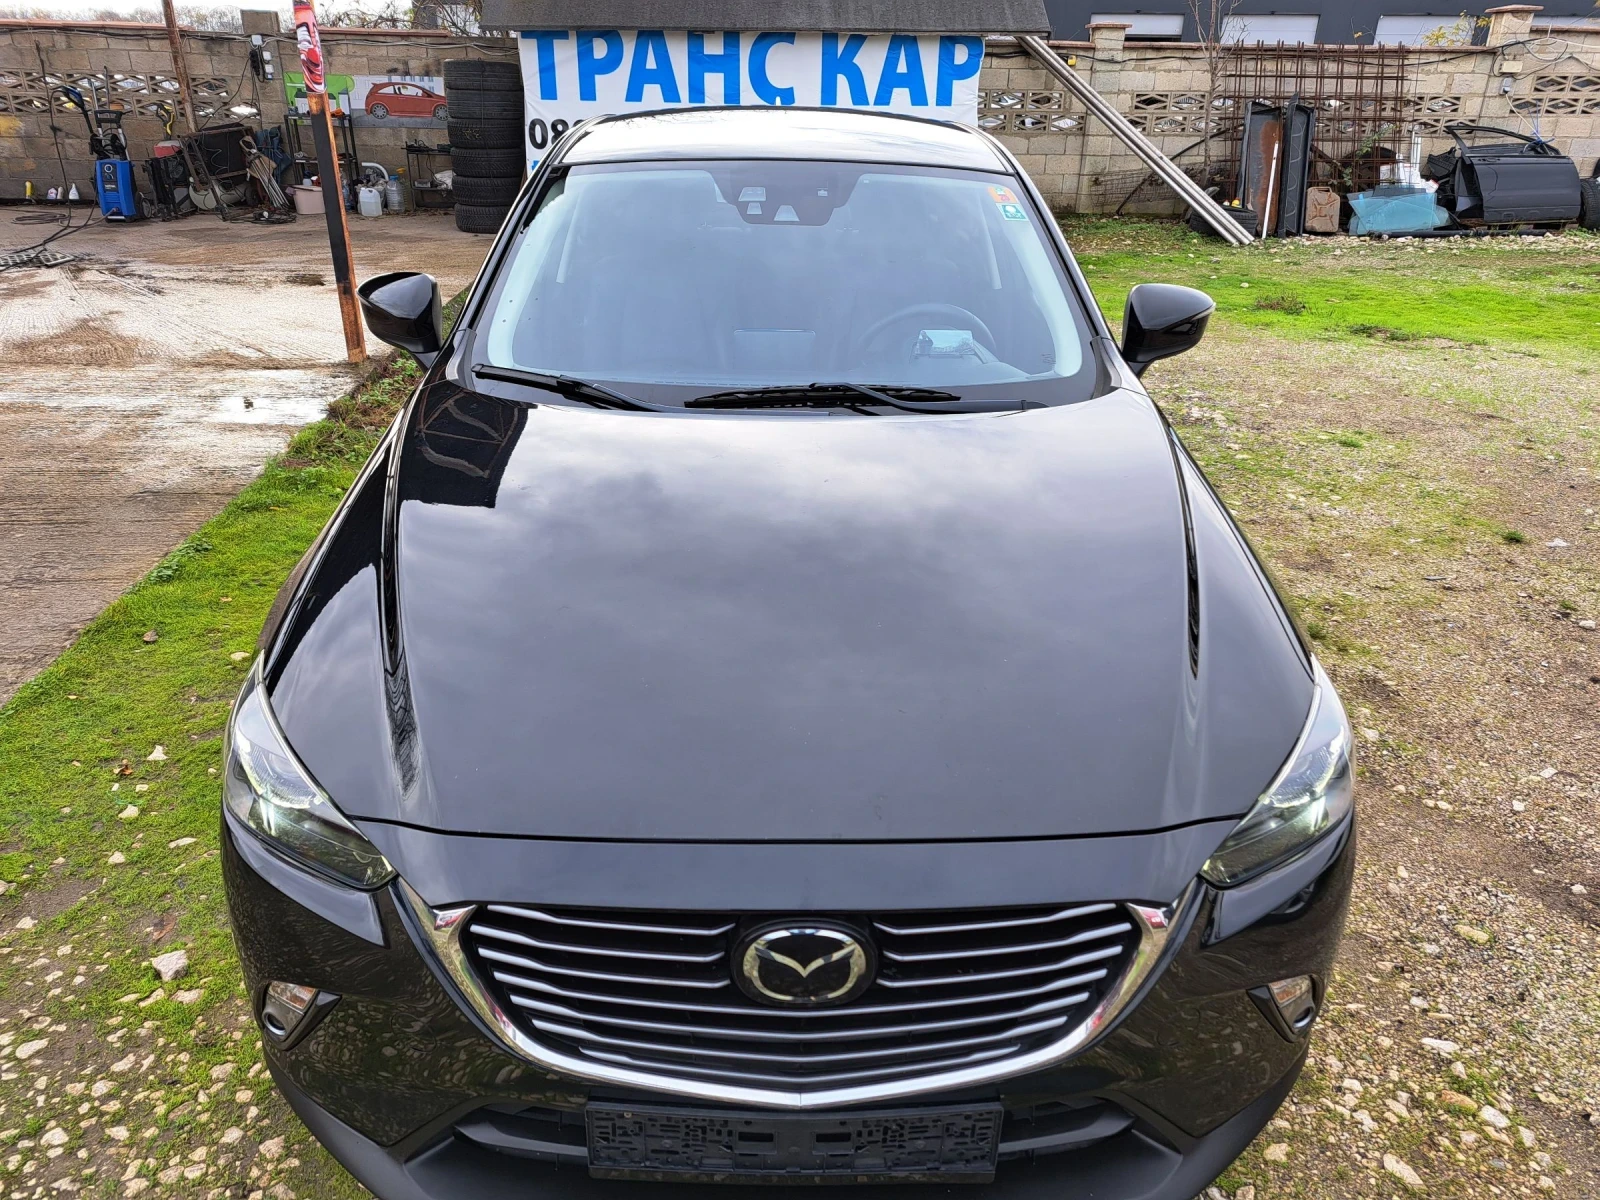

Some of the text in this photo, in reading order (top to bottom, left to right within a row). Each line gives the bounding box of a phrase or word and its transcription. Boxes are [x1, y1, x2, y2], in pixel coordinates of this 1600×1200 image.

[521, 30, 983, 106] ТРАНС КАР
[529, 118, 584, 149] 08
